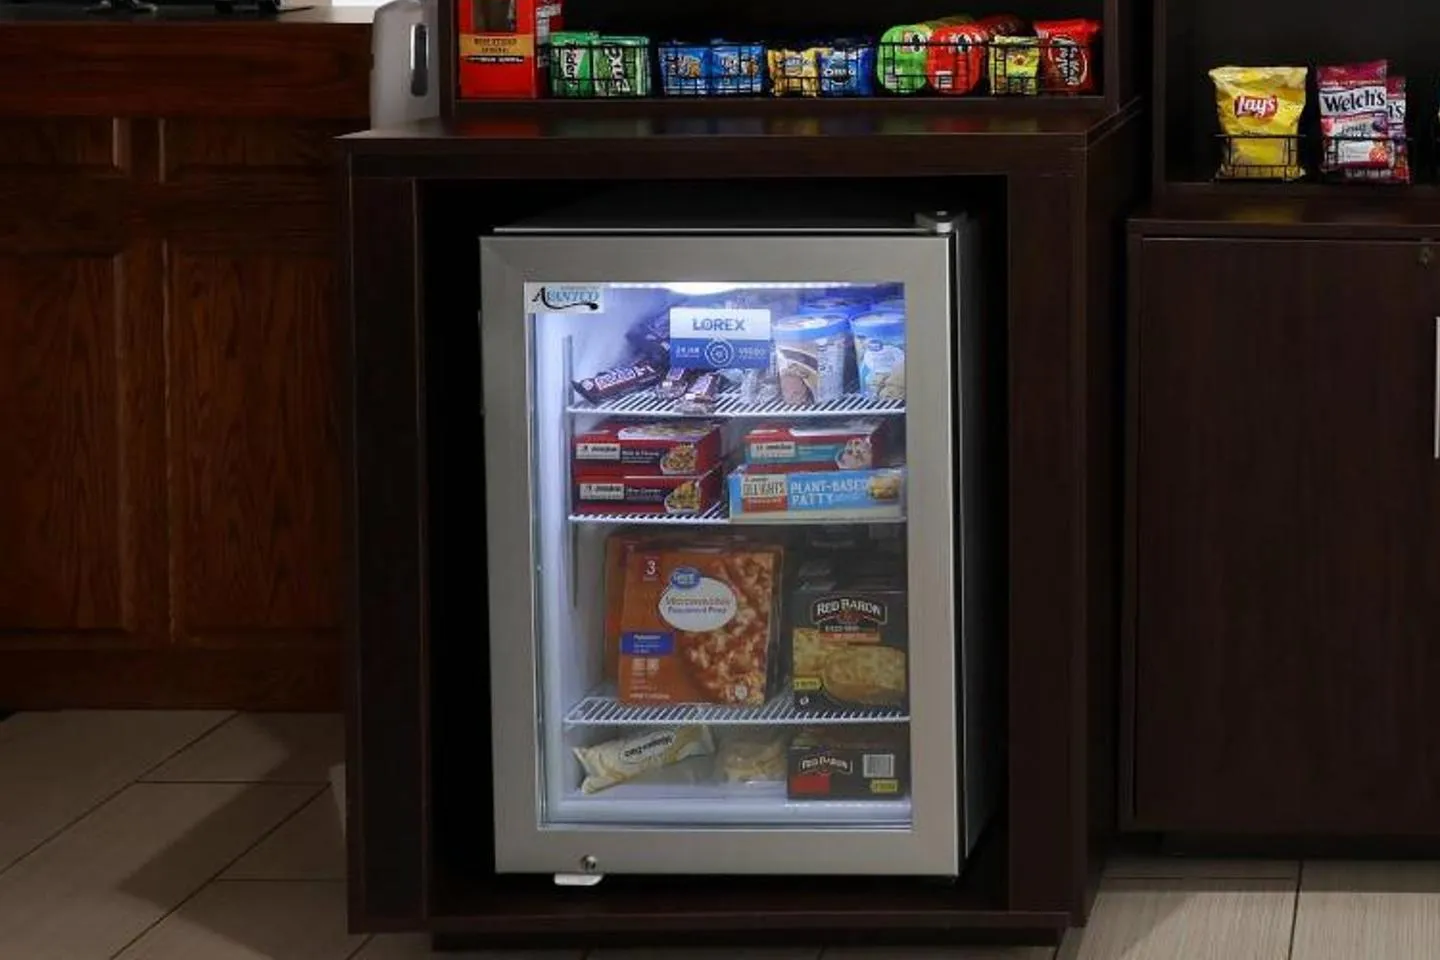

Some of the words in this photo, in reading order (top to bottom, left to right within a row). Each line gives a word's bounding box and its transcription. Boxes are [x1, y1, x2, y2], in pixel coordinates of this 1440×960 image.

[1236, 95, 1276, 118] Lay's
[1323, 89, 1385, 112] Welch's
[692, 318, 746, 331] LOREX
[790, 480, 868, 494] PLANT-BASED
[792, 493, 833, 506] PATTY
[646, 560, 656, 575] 3
[816, 601, 839, 616] RED
[841, 598, 881, 616] BARON
